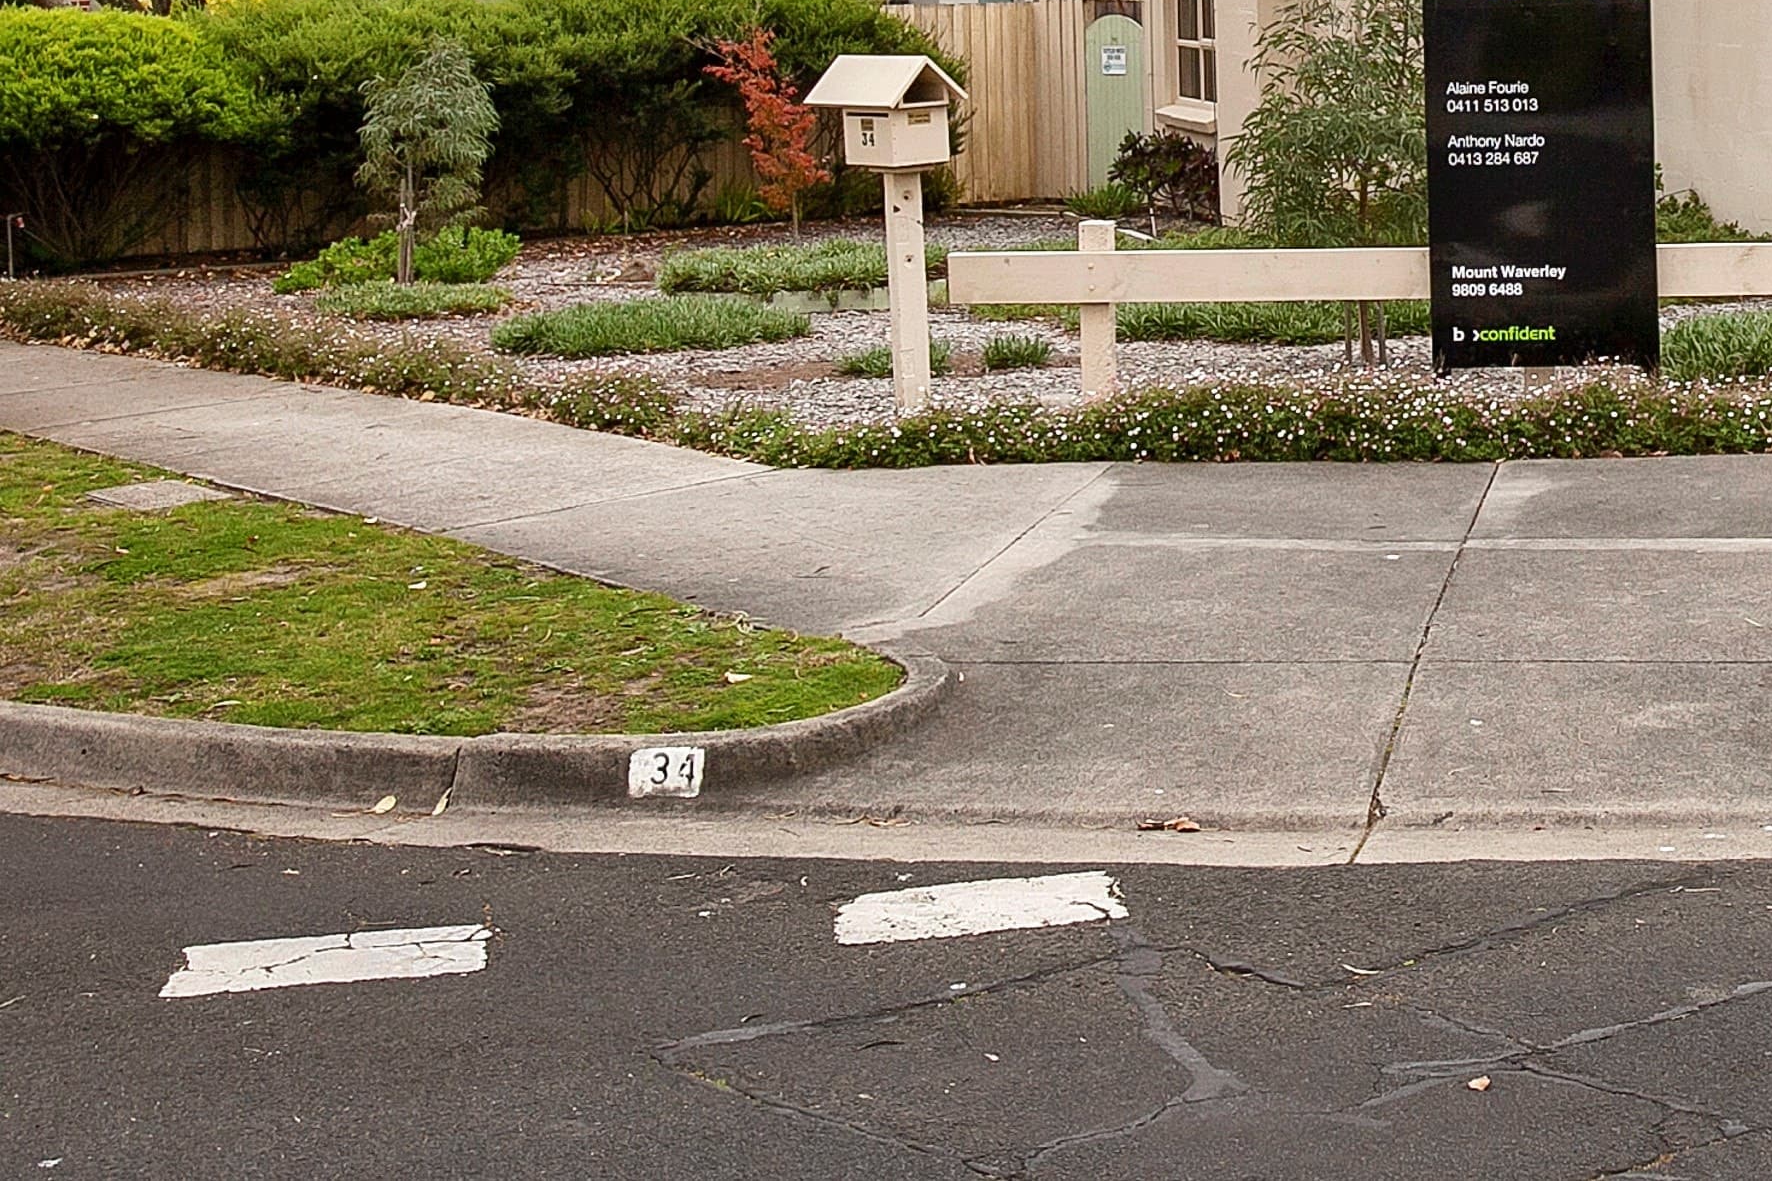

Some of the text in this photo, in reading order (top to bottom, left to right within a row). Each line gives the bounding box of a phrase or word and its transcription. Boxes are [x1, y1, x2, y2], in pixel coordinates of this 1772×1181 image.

[1446, 80, 1530, 96] Alaine Fourie
[1446, 97, 1540, 113] 0411 513 013
[861, 131, 876, 148] 34
[1447, 133, 1546, 151] Anthony Nardo
[1448, 150, 1540, 166] 0413 284 687
[1451, 263, 1568, 280] Mount Waverley
[1451, 282, 1524, 297] 9809 6488
[1452, 325, 1557, 342] b confident
[650, 752, 696, 789] 34
